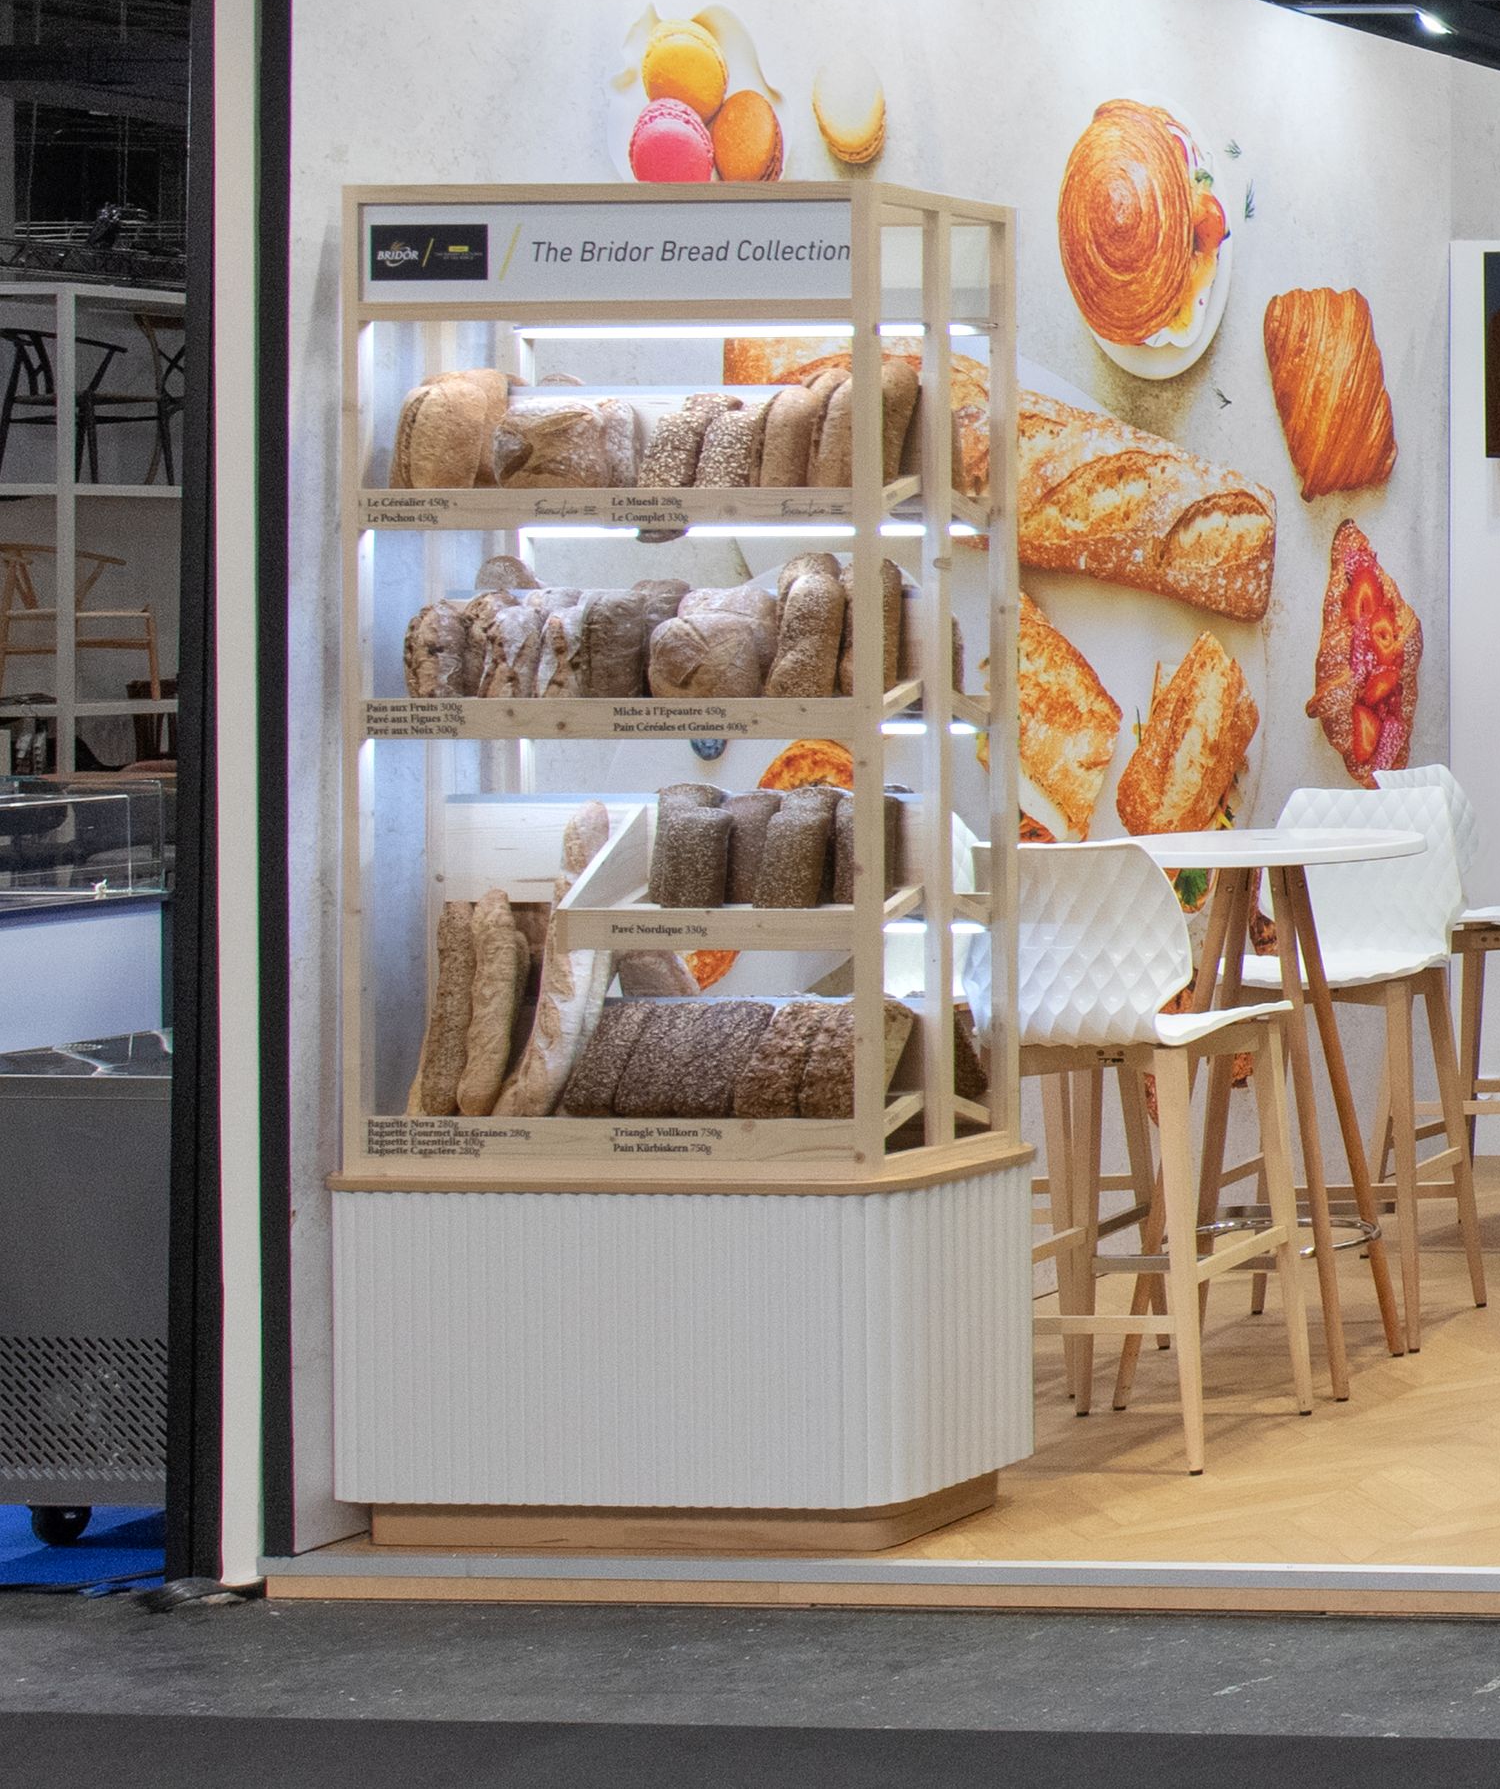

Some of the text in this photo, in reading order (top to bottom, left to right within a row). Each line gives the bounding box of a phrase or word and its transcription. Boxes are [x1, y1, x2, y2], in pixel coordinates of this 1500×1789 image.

[376, 249, 420, 263] BRIDOR
[531, 238, 851, 263] The Bridor Bread Collection
[636, 924, 683, 936] Nordique
